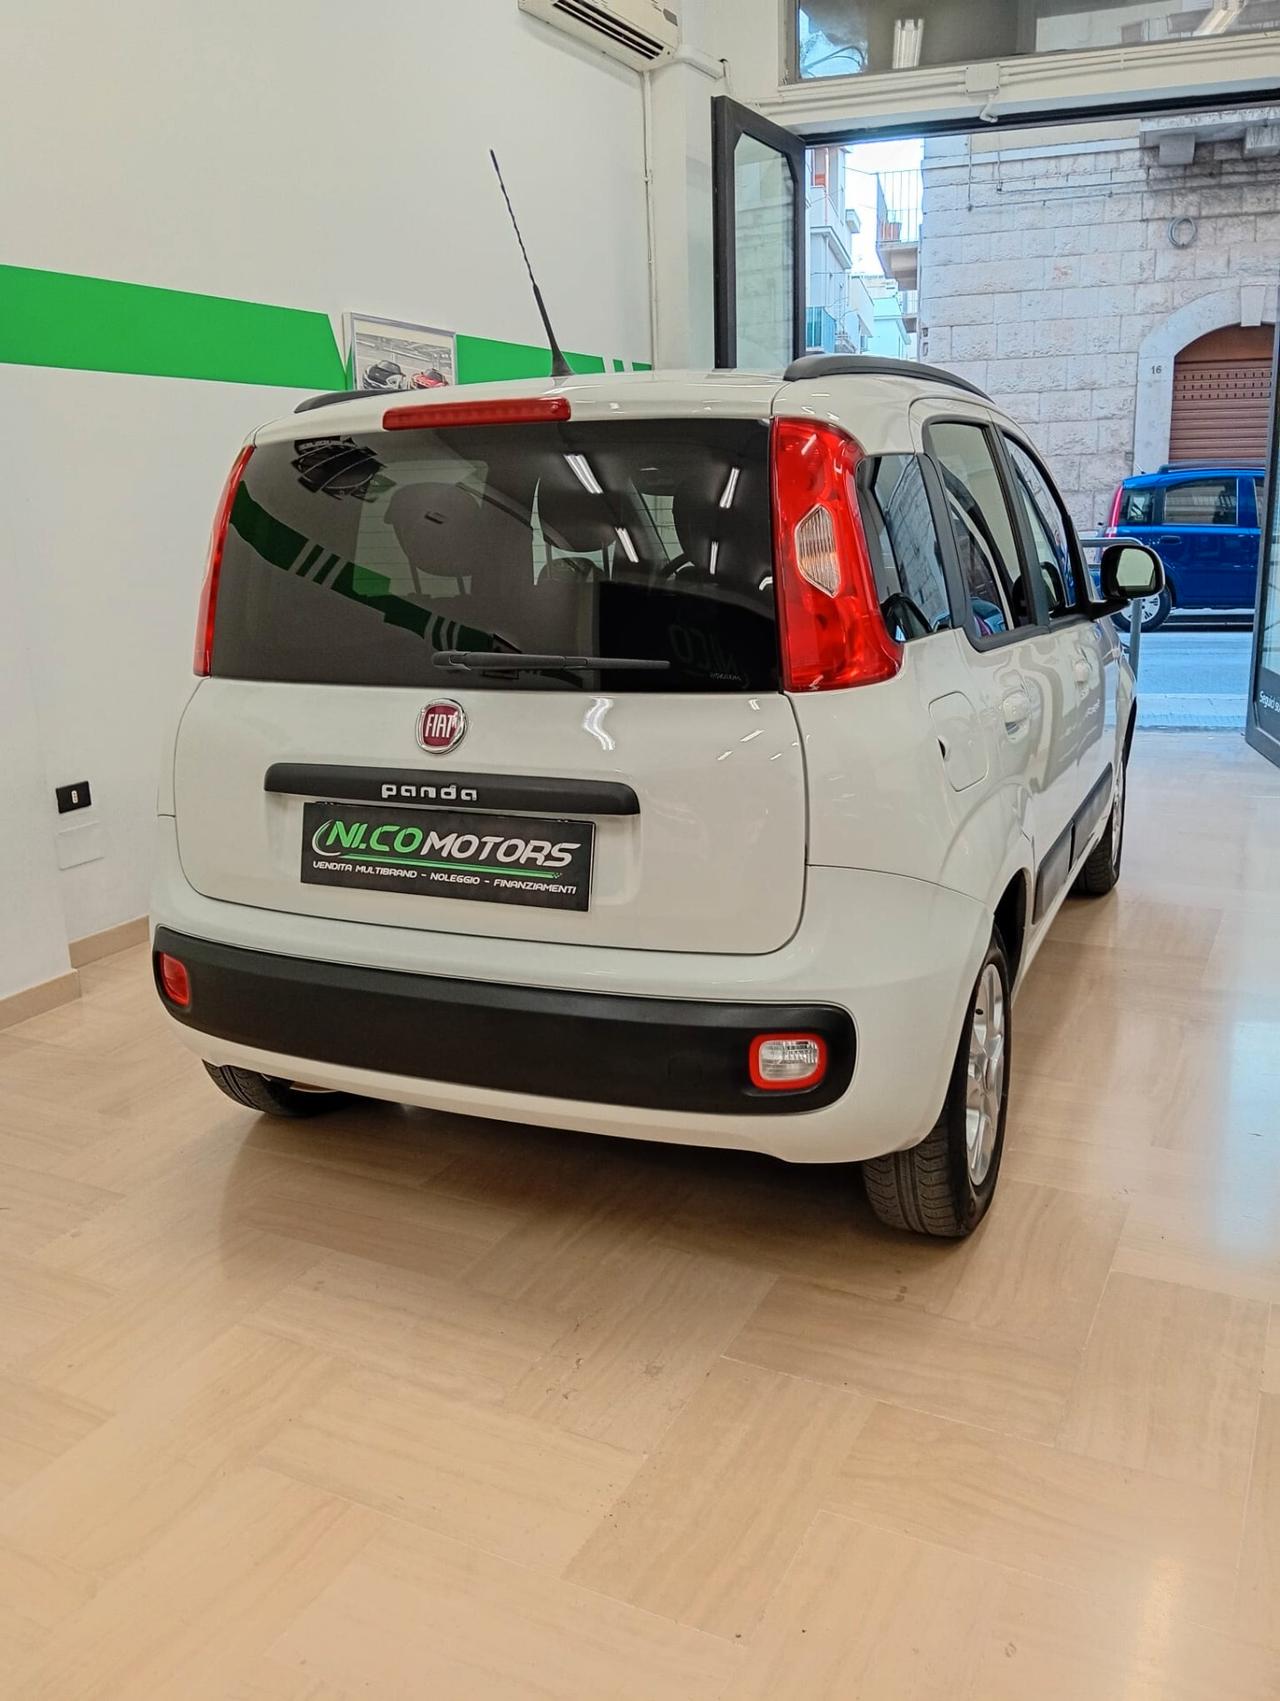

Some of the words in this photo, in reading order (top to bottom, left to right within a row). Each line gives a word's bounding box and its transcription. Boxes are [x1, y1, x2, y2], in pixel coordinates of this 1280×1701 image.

[1151, 365, 1162, 375] 16
[424, 713, 457, 738] FIAT
[381, 783, 478, 801] panda
[312, 860, 353, 873] VENDITA
[355, 865, 418, 879] MULTIBRAND
[430, 872, 481, 885] NOLEGGIO
[493, 878, 577, 895] FINANZIAMENTI
